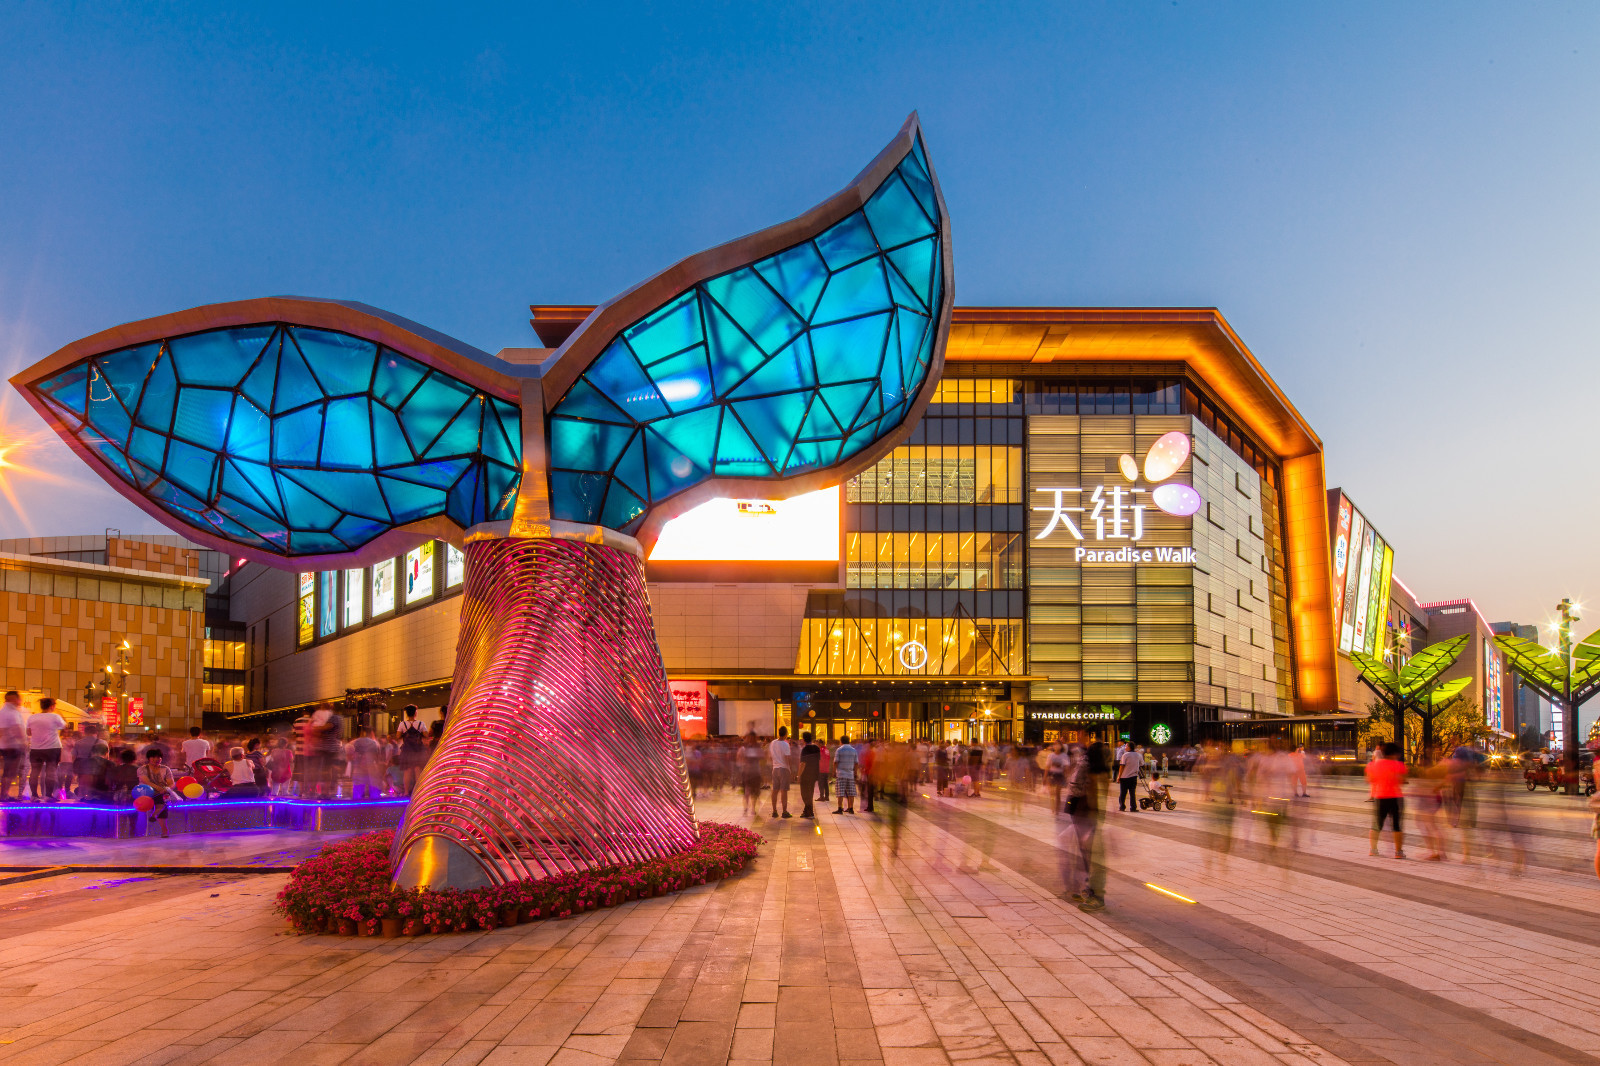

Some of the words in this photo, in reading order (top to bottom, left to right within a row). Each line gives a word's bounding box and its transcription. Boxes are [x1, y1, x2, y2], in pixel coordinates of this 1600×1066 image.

[1032, 485, 1147, 541] 天街
[1075, 547, 1153, 563] Paradise
[1155, 547, 1197, 563] Walk
[1031, 712, 1082, 720] STARBUCKS
